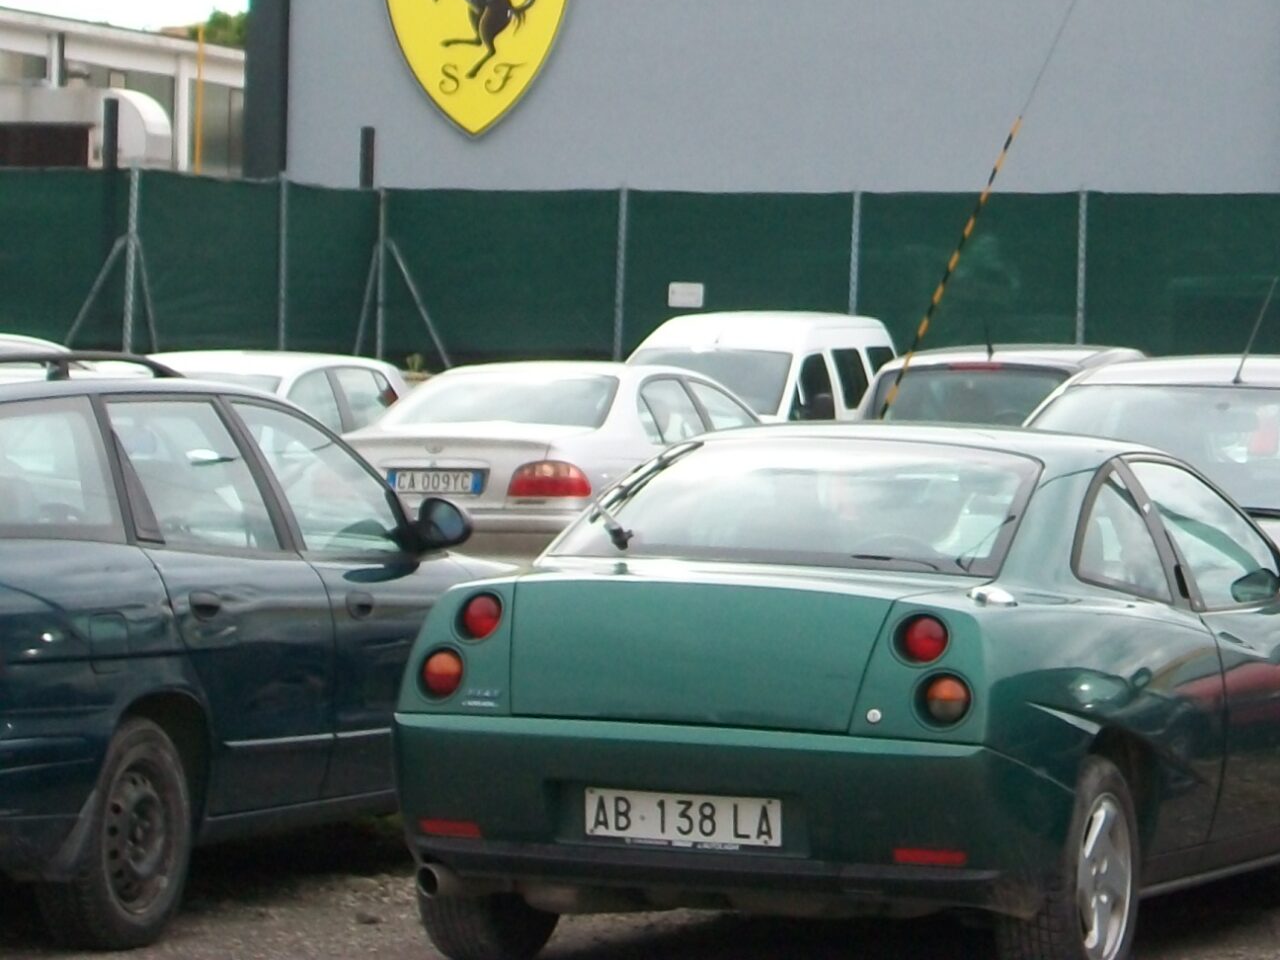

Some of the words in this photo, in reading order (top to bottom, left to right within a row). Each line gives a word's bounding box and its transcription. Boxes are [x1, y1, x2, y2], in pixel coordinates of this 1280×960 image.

[397, 472, 415, 490] CA
[593, 795, 632, 831] AB
[656, 799, 716, 837] 138
[733, 803, 773, 840] LA
